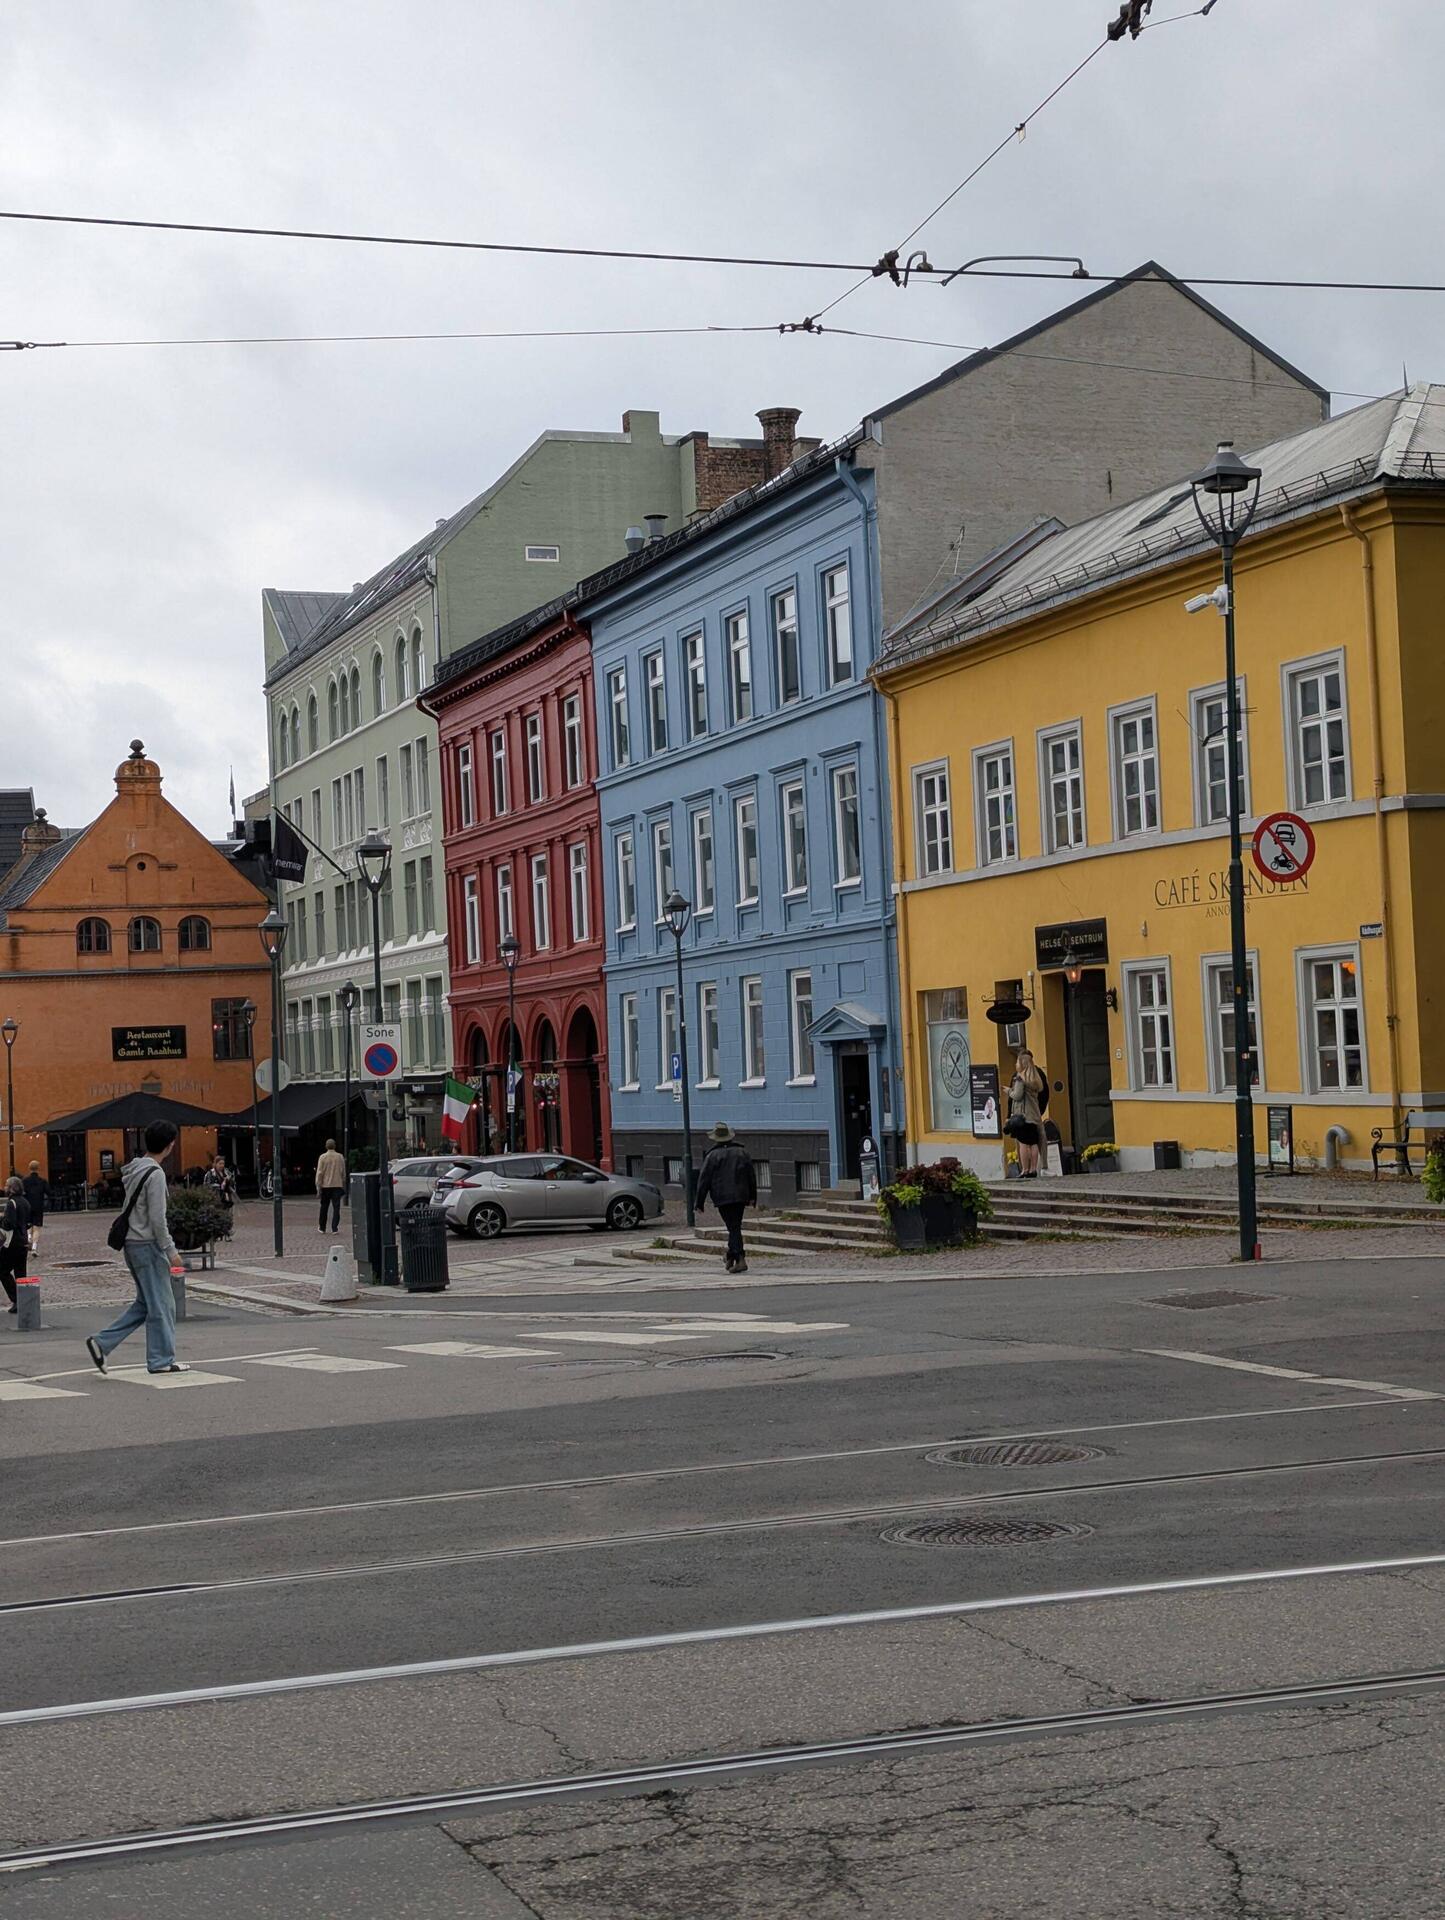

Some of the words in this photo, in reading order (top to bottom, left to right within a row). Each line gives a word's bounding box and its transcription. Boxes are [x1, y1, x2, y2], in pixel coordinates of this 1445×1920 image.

[1154, 868, 1200, 907] CAFÉ
[1040, 937, 1062, 950] HELSE
[1070, 932, 1104, 946] SENTRUM
[127, 1029, 171, 1040] Restaurant
[366, 1027, 395, 1038] Sone
[117, 1047, 145, 1057] Gamle
[672, 1056, 679, 1077] P
